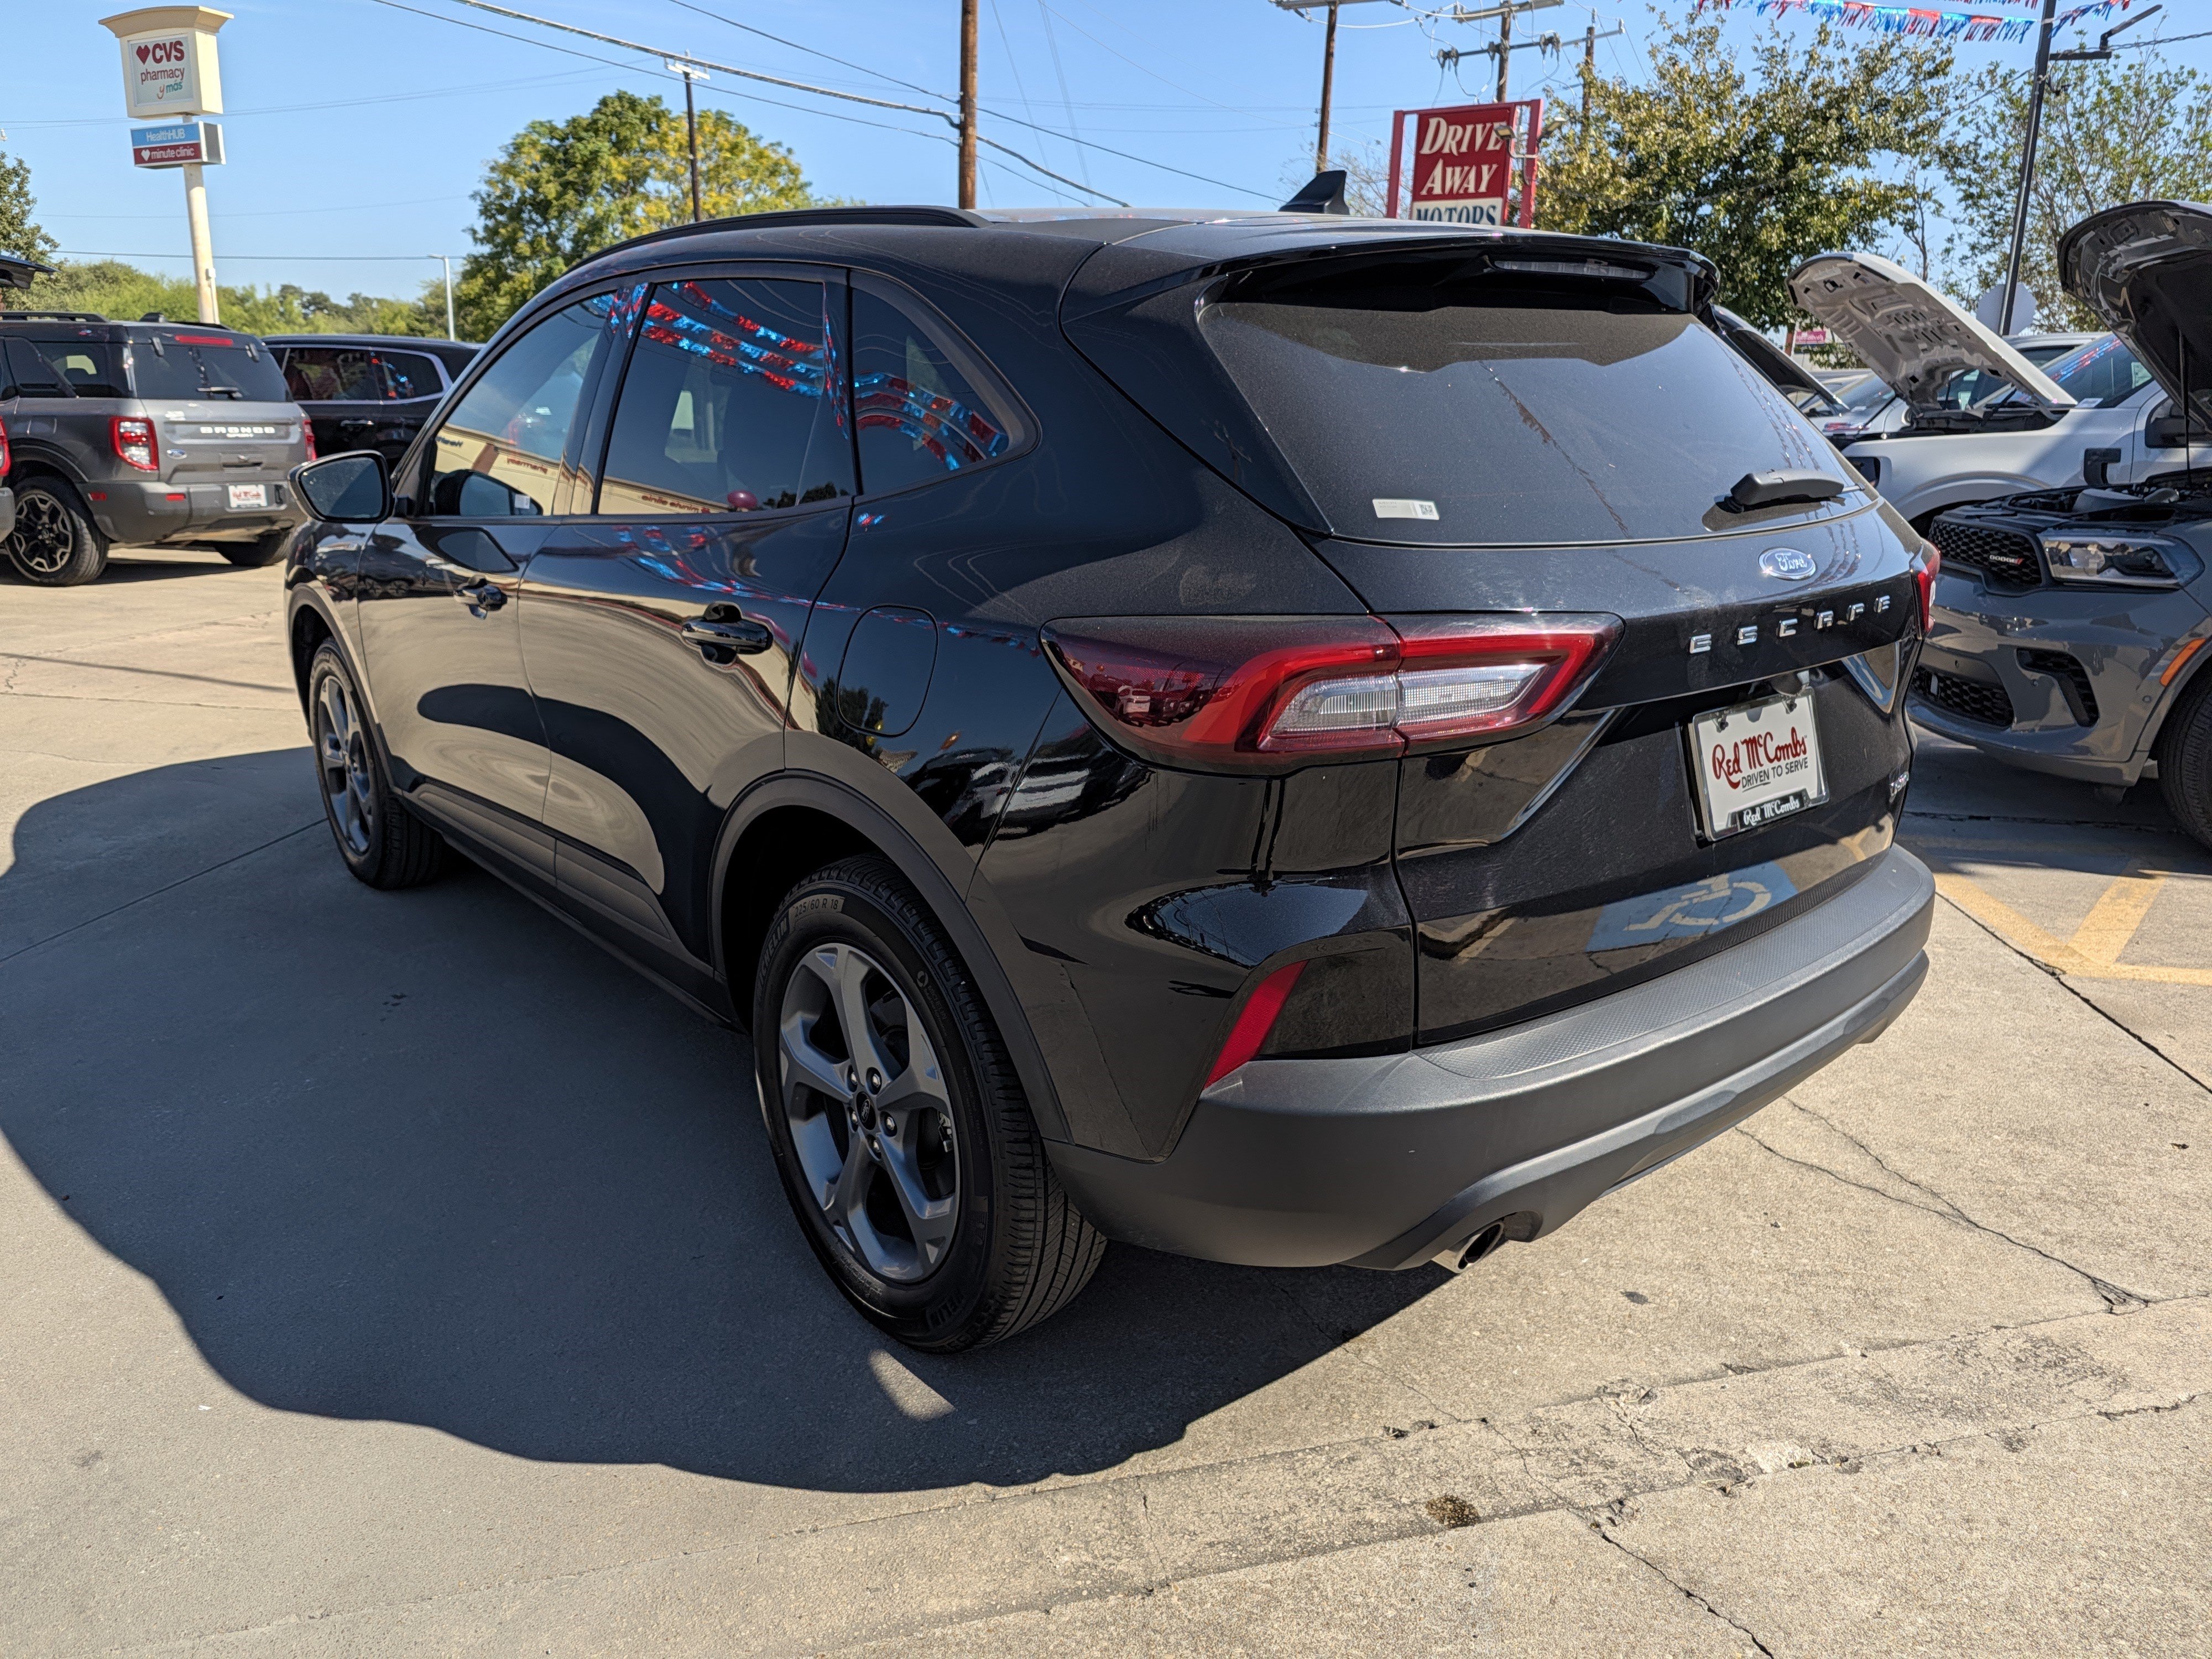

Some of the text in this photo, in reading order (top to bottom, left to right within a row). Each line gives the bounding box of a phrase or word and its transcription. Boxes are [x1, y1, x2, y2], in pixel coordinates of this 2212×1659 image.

[152, 40, 185, 64] CVS
[140, 67, 185, 85] pharmacy
[157, 84, 165, 100] y
[145, 128, 185, 142] HealthHUB
[1419, 117, 1507, 156] DRIVE
[151, 146, 195, 159] minute clinic
[1420, 158, 1499, 195] AWAY
[1775, 552, 1807, 571] Ford
[1989, 555, 2016, 563] DODGE
[1689, 595, 1891, 654] ESCAPE
[1712, 744, 1743, 790] Red
[1742, 757, 1808, 789] DRIVEN TO SERVE
[1743, 808, 1761, 826] Red
[795, 898, 839, 917] 225/60 R 18
